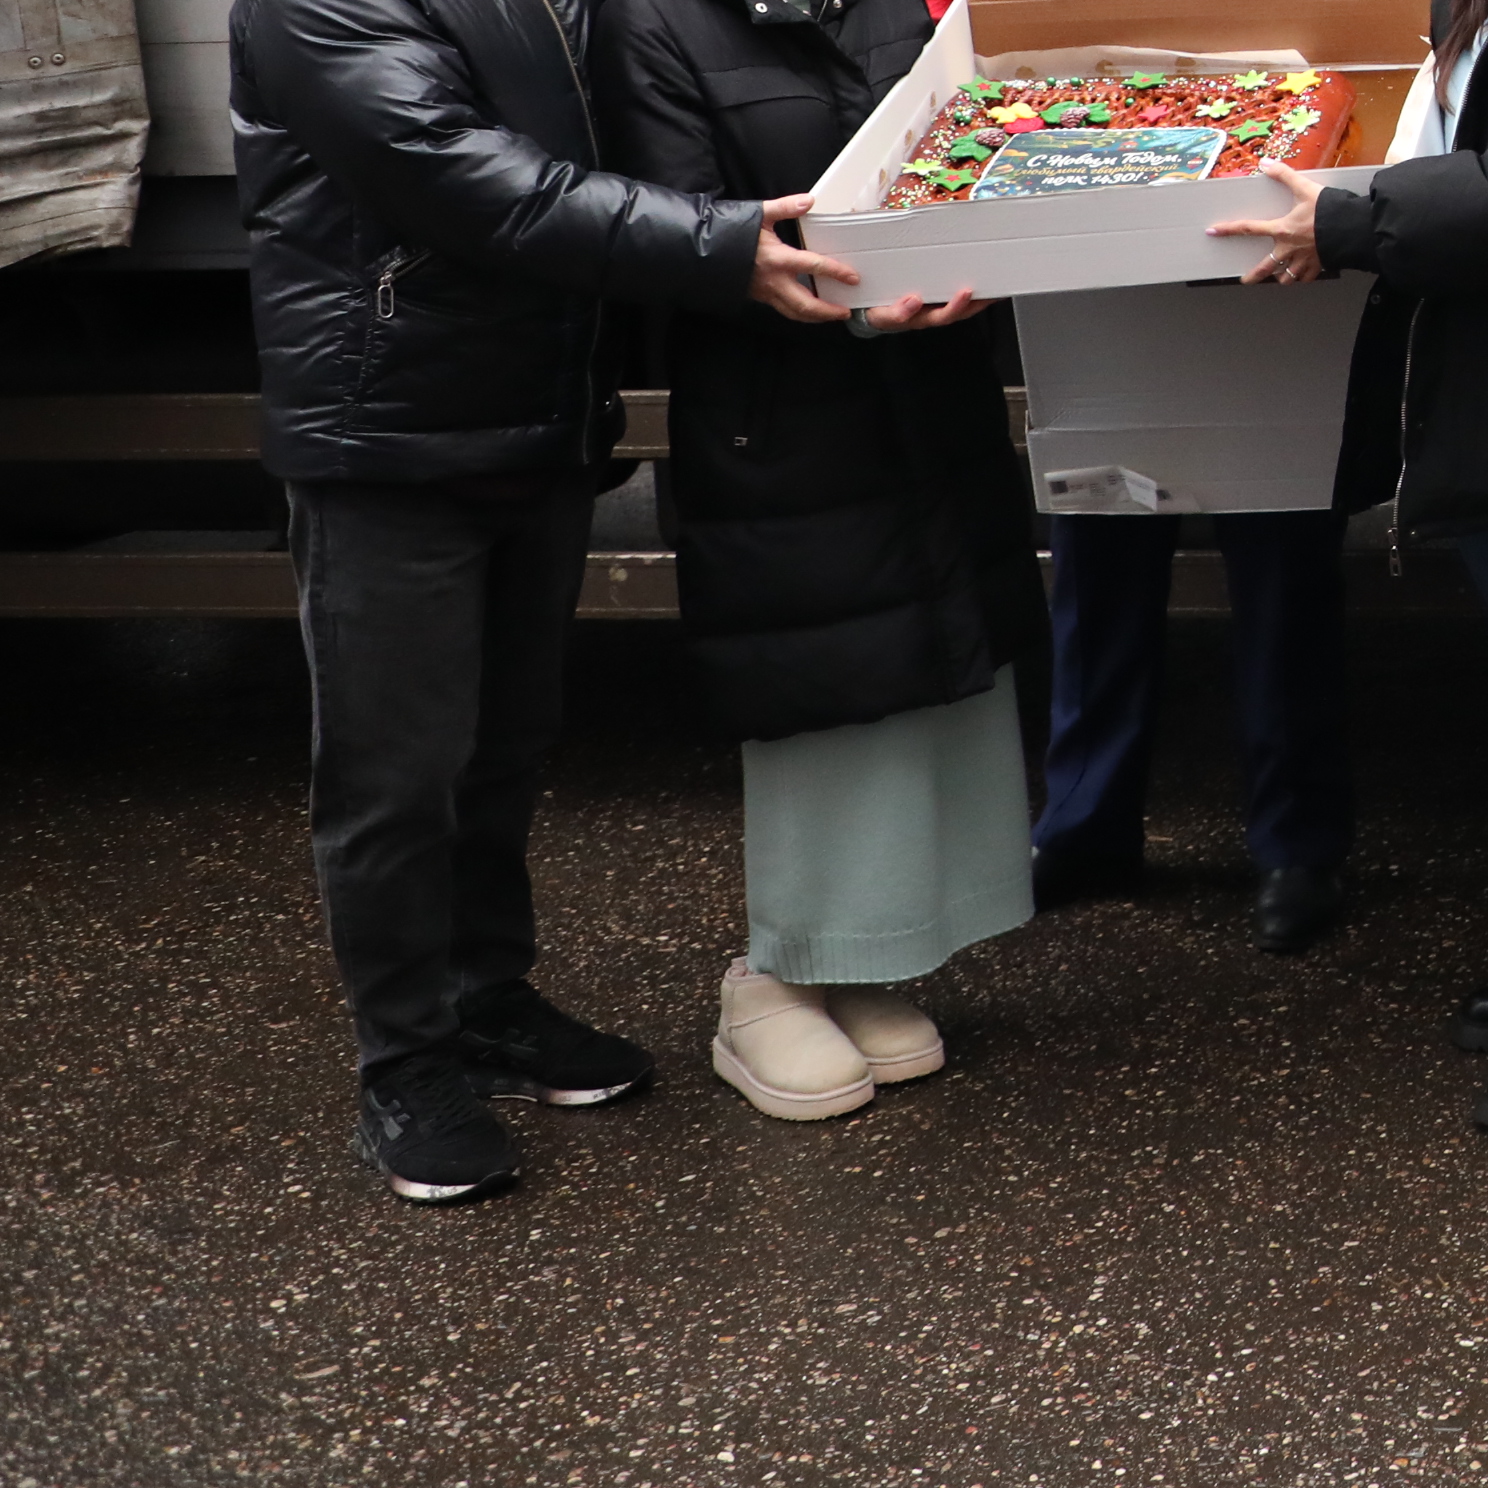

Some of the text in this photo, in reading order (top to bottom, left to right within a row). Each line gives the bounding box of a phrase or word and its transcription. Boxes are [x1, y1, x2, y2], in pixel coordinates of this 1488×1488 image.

[1027, 154, 1043, 167] С
[1047, 152, 1118, 168] Новым
[1016, 163, 1180, 177] любимый гвардейский
[1041, 172, 1142, 186] полк 1430!
